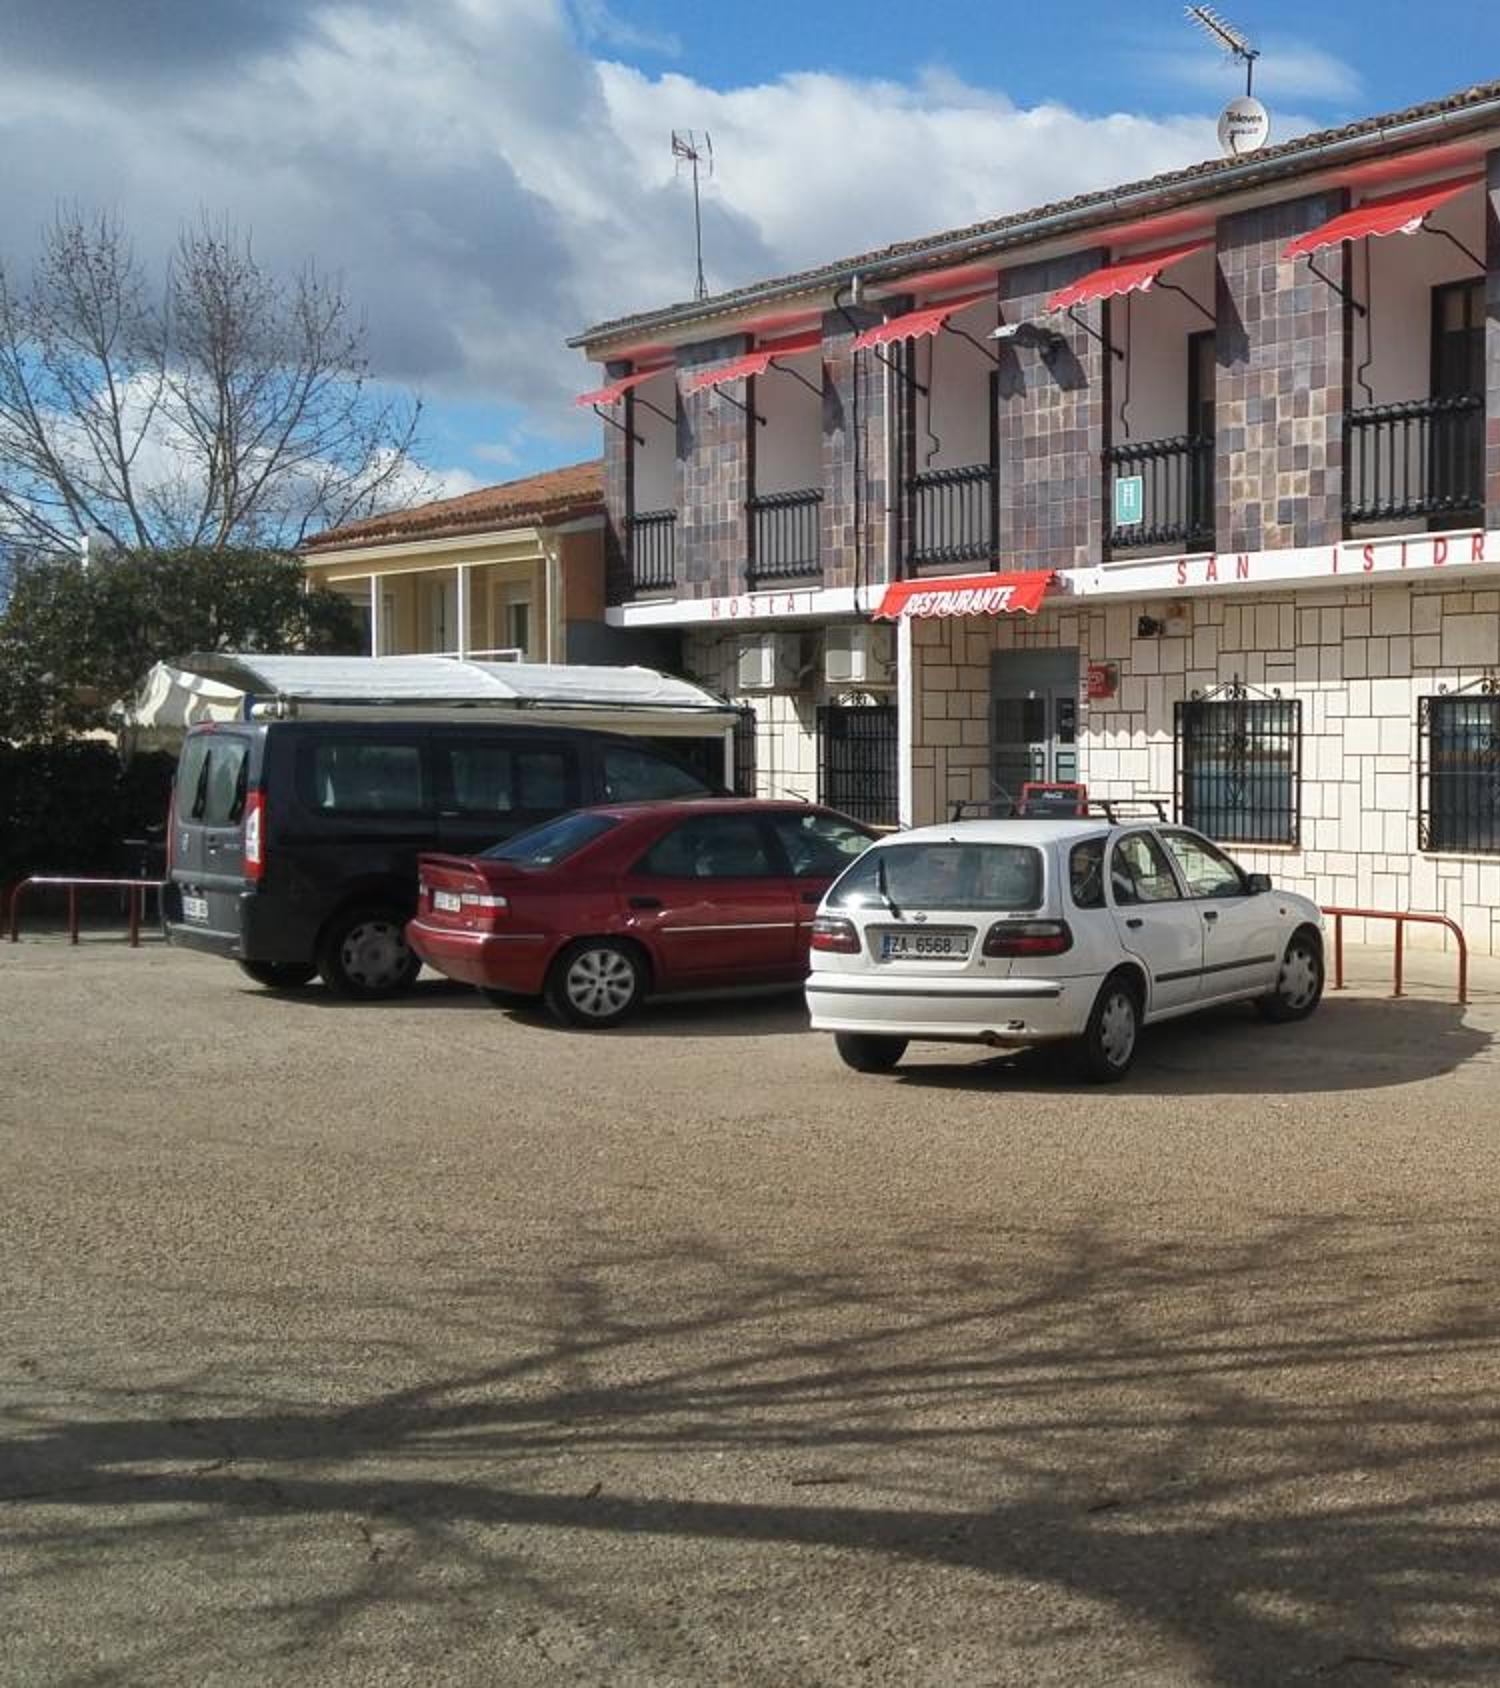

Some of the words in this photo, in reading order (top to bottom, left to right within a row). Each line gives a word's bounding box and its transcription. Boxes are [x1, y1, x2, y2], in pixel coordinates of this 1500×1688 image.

[1177, 555, 1249, 585] SAN
[904, 585, 1016, 616] RESTAURANTE
[916, 937, 951, 953] 6568
